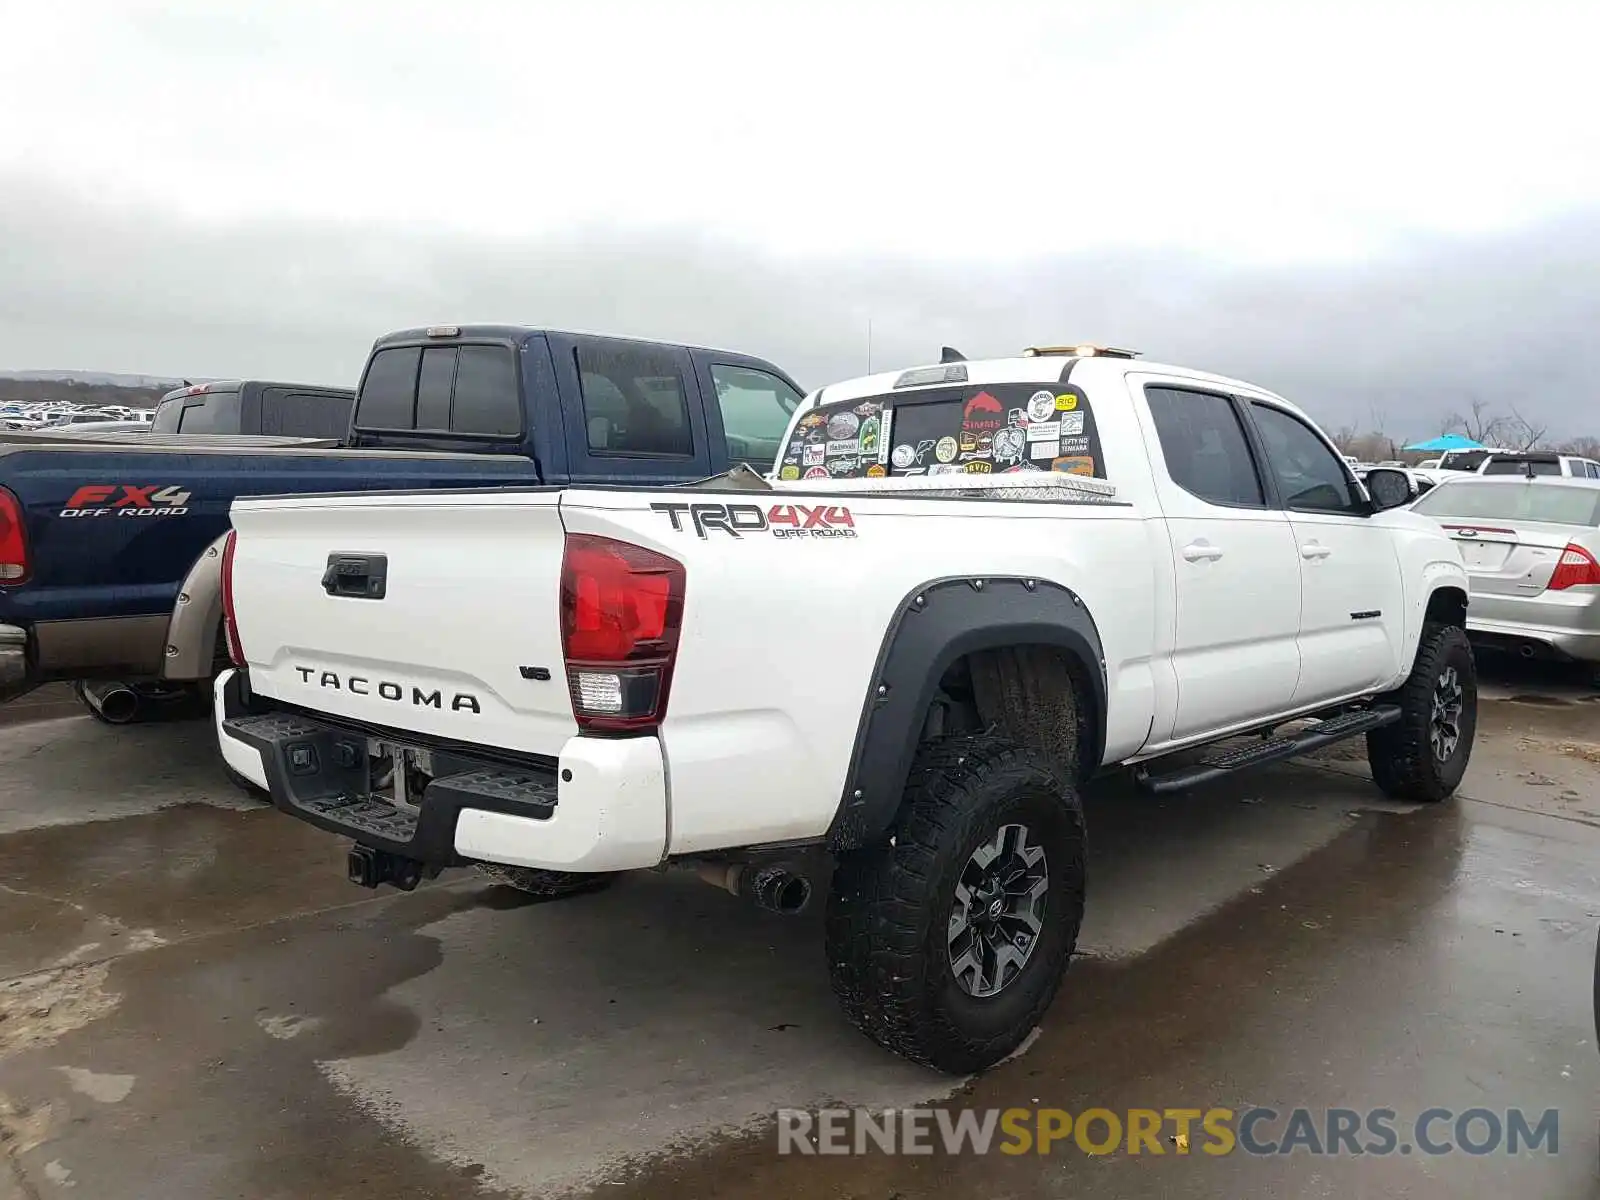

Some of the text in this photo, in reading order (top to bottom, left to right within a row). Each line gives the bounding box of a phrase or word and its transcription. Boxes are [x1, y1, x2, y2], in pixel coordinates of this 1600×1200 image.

[1057, 397, 1075, 405] RIO
[65, 485, 192, 507] FX4
[59, 507, 189, 518] OFF ROAD
[650, 502, 855, 540] TRD 4X4
[772, 528, 858, 539] OFF ROAD
[518, 665, 551, 681] V6
[295, 666, 481, 714] TACOMA
